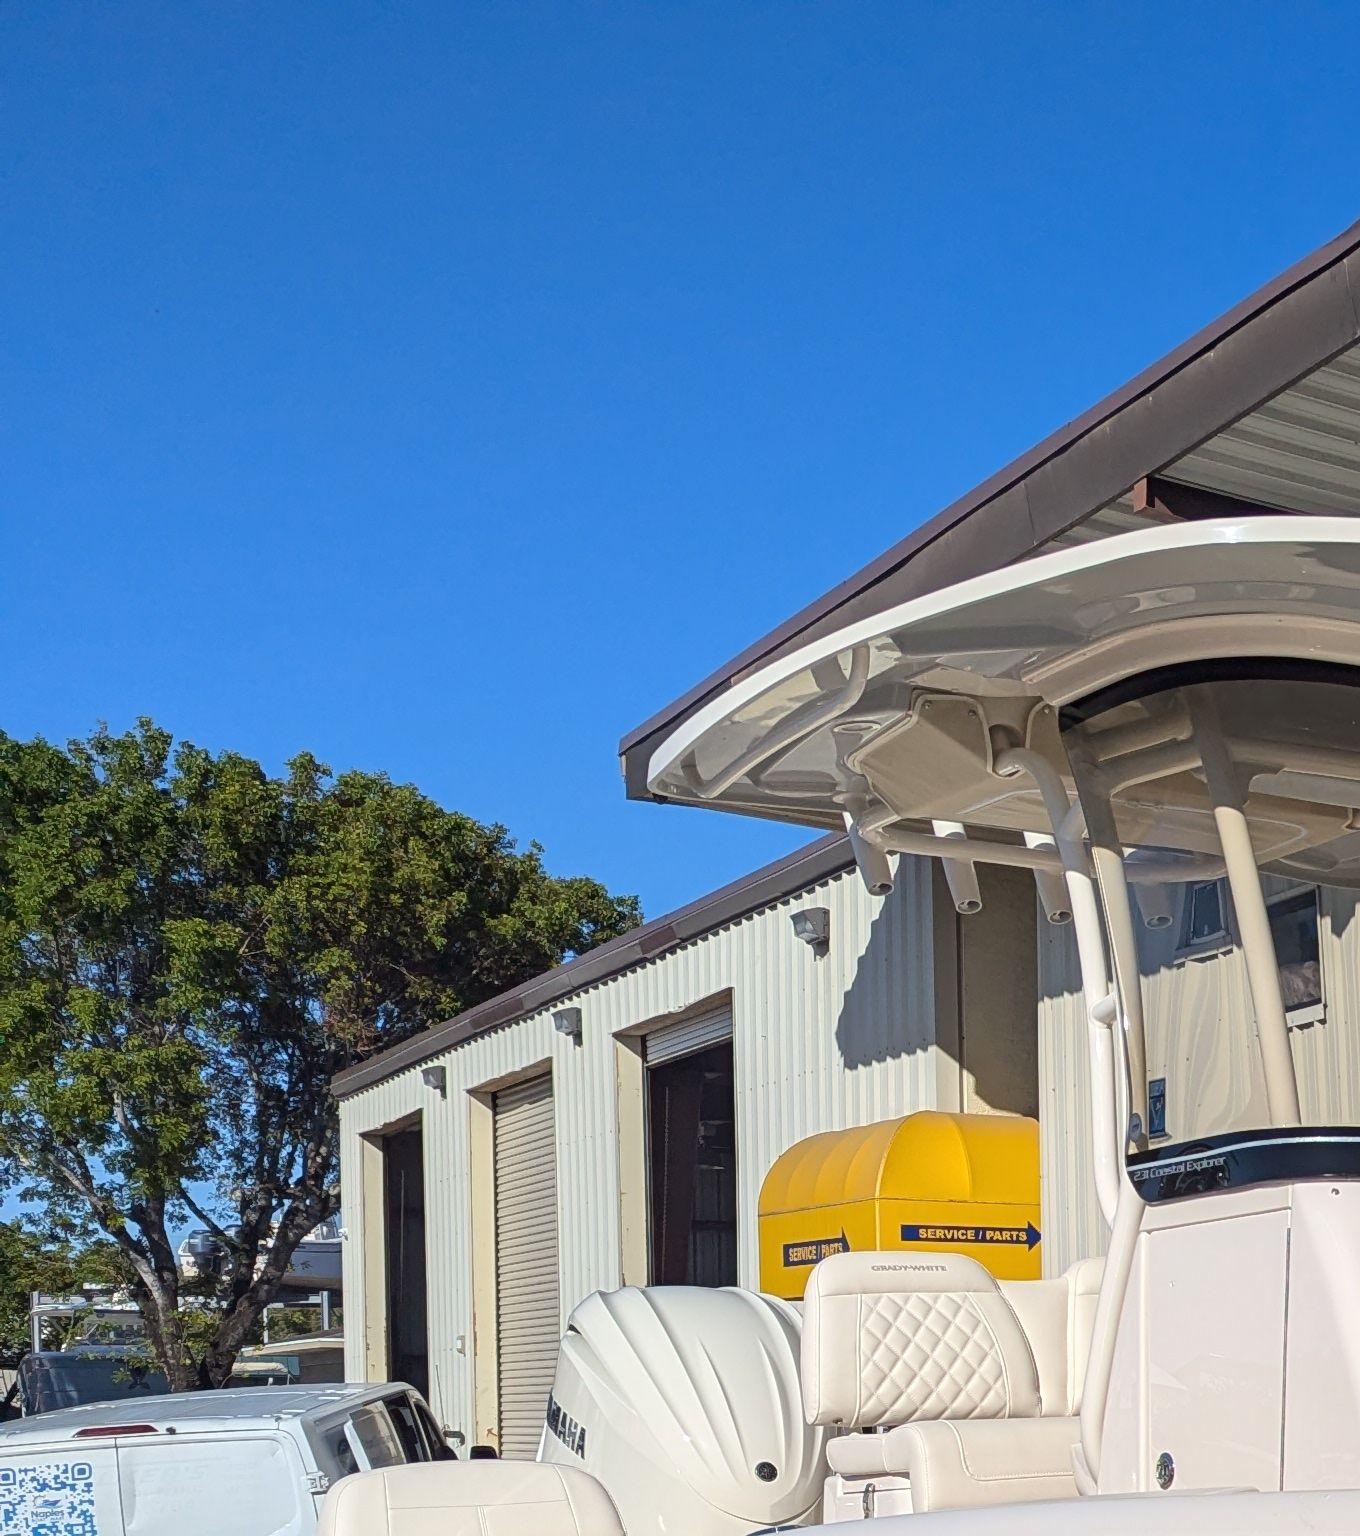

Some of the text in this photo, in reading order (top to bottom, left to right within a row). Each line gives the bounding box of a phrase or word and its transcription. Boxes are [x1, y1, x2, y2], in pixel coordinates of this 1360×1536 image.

[1133, 1156, 1227, 1181] 231 Coastal Explorer
[918, 1227, 976, 1241] SERVICE
[985, 1229, 1028, 1242] PARTS
[788, 1245, 817, 1262] SERVICE
[870, 1264, 947, 1272] GRADY-WHITE
